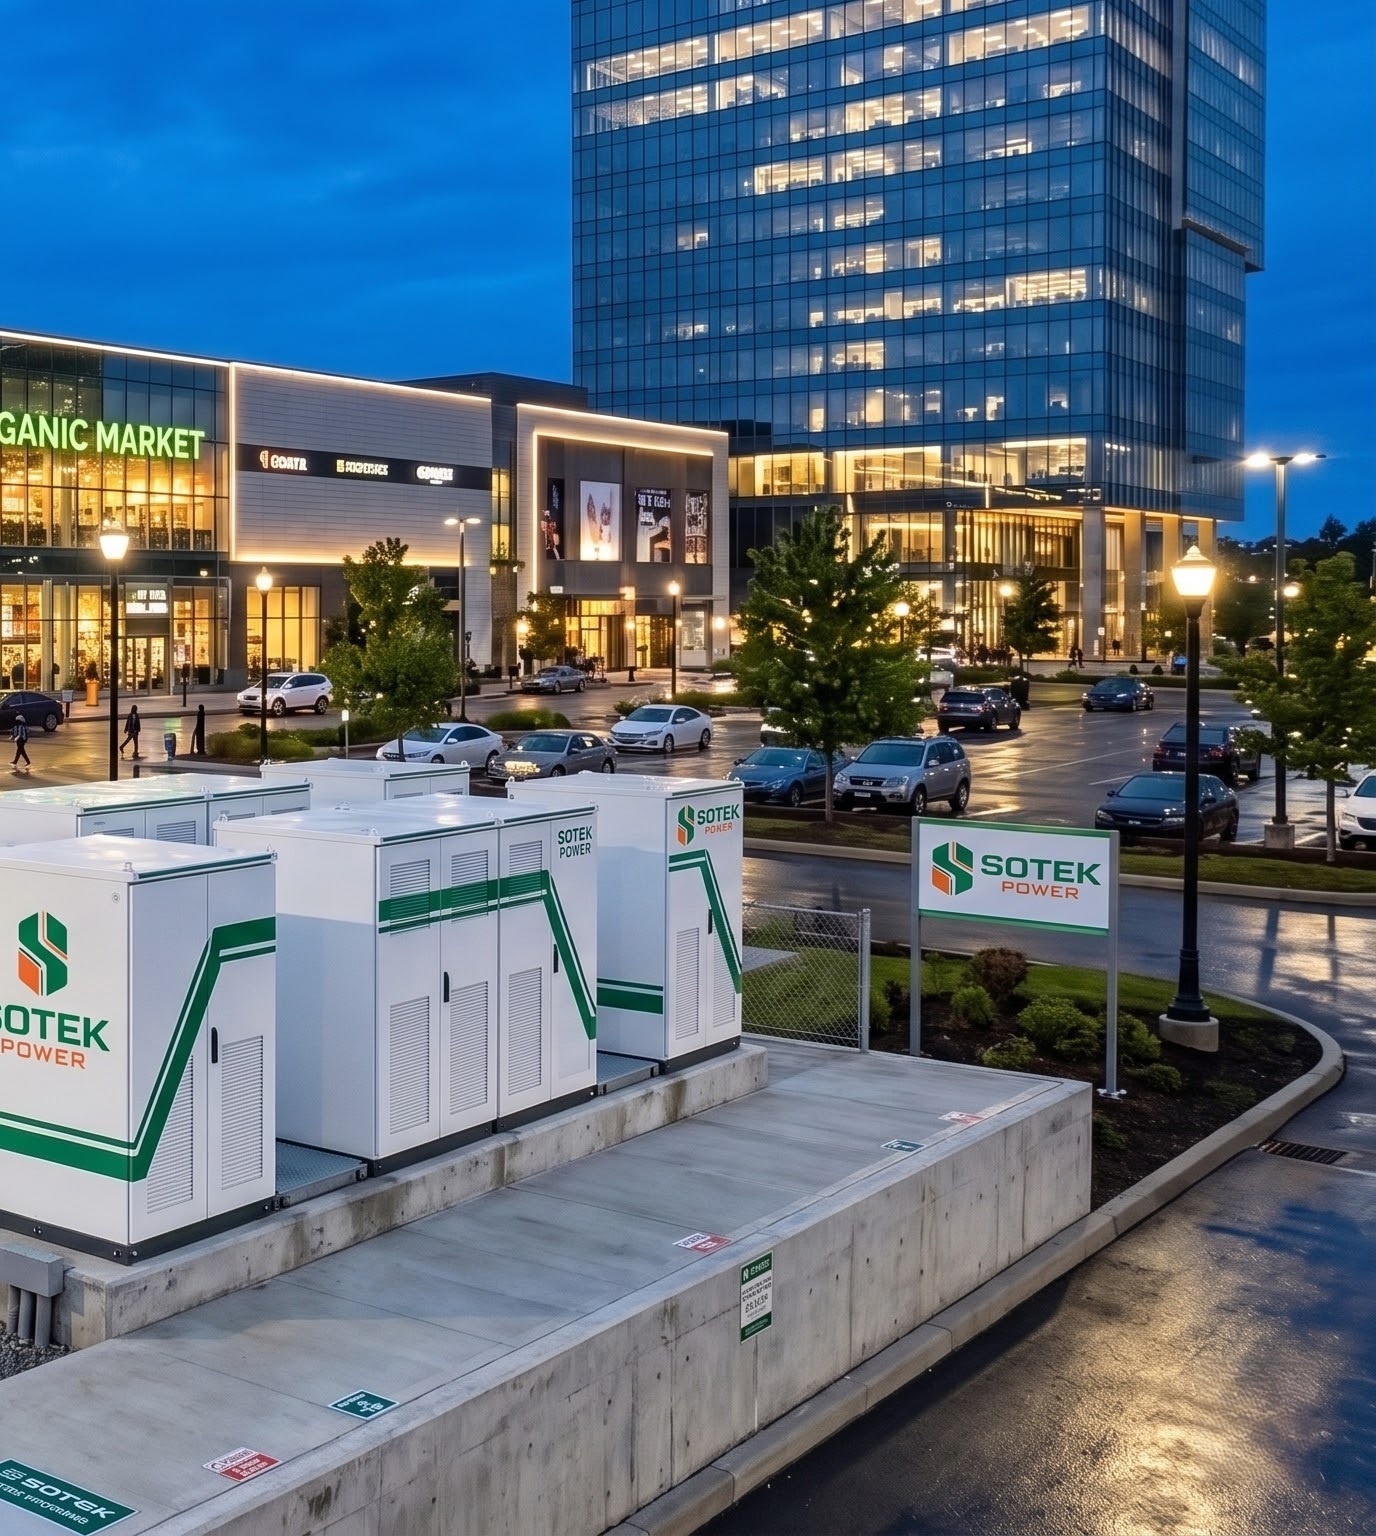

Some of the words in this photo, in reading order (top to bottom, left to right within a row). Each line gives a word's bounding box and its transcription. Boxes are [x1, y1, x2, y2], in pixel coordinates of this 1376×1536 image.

[96, 420, 206, 460] MARKET
[697, 803, 740, 826] SOTEK
[557, 825, 593, 845] SOTEK
[980, 854, 1102, 886] SOTEK
[1001, 880, 1079, 900] POWER
[0, 1037, 86, 1070] POWER
[20, 1476, 116, 1520] SOTEK
